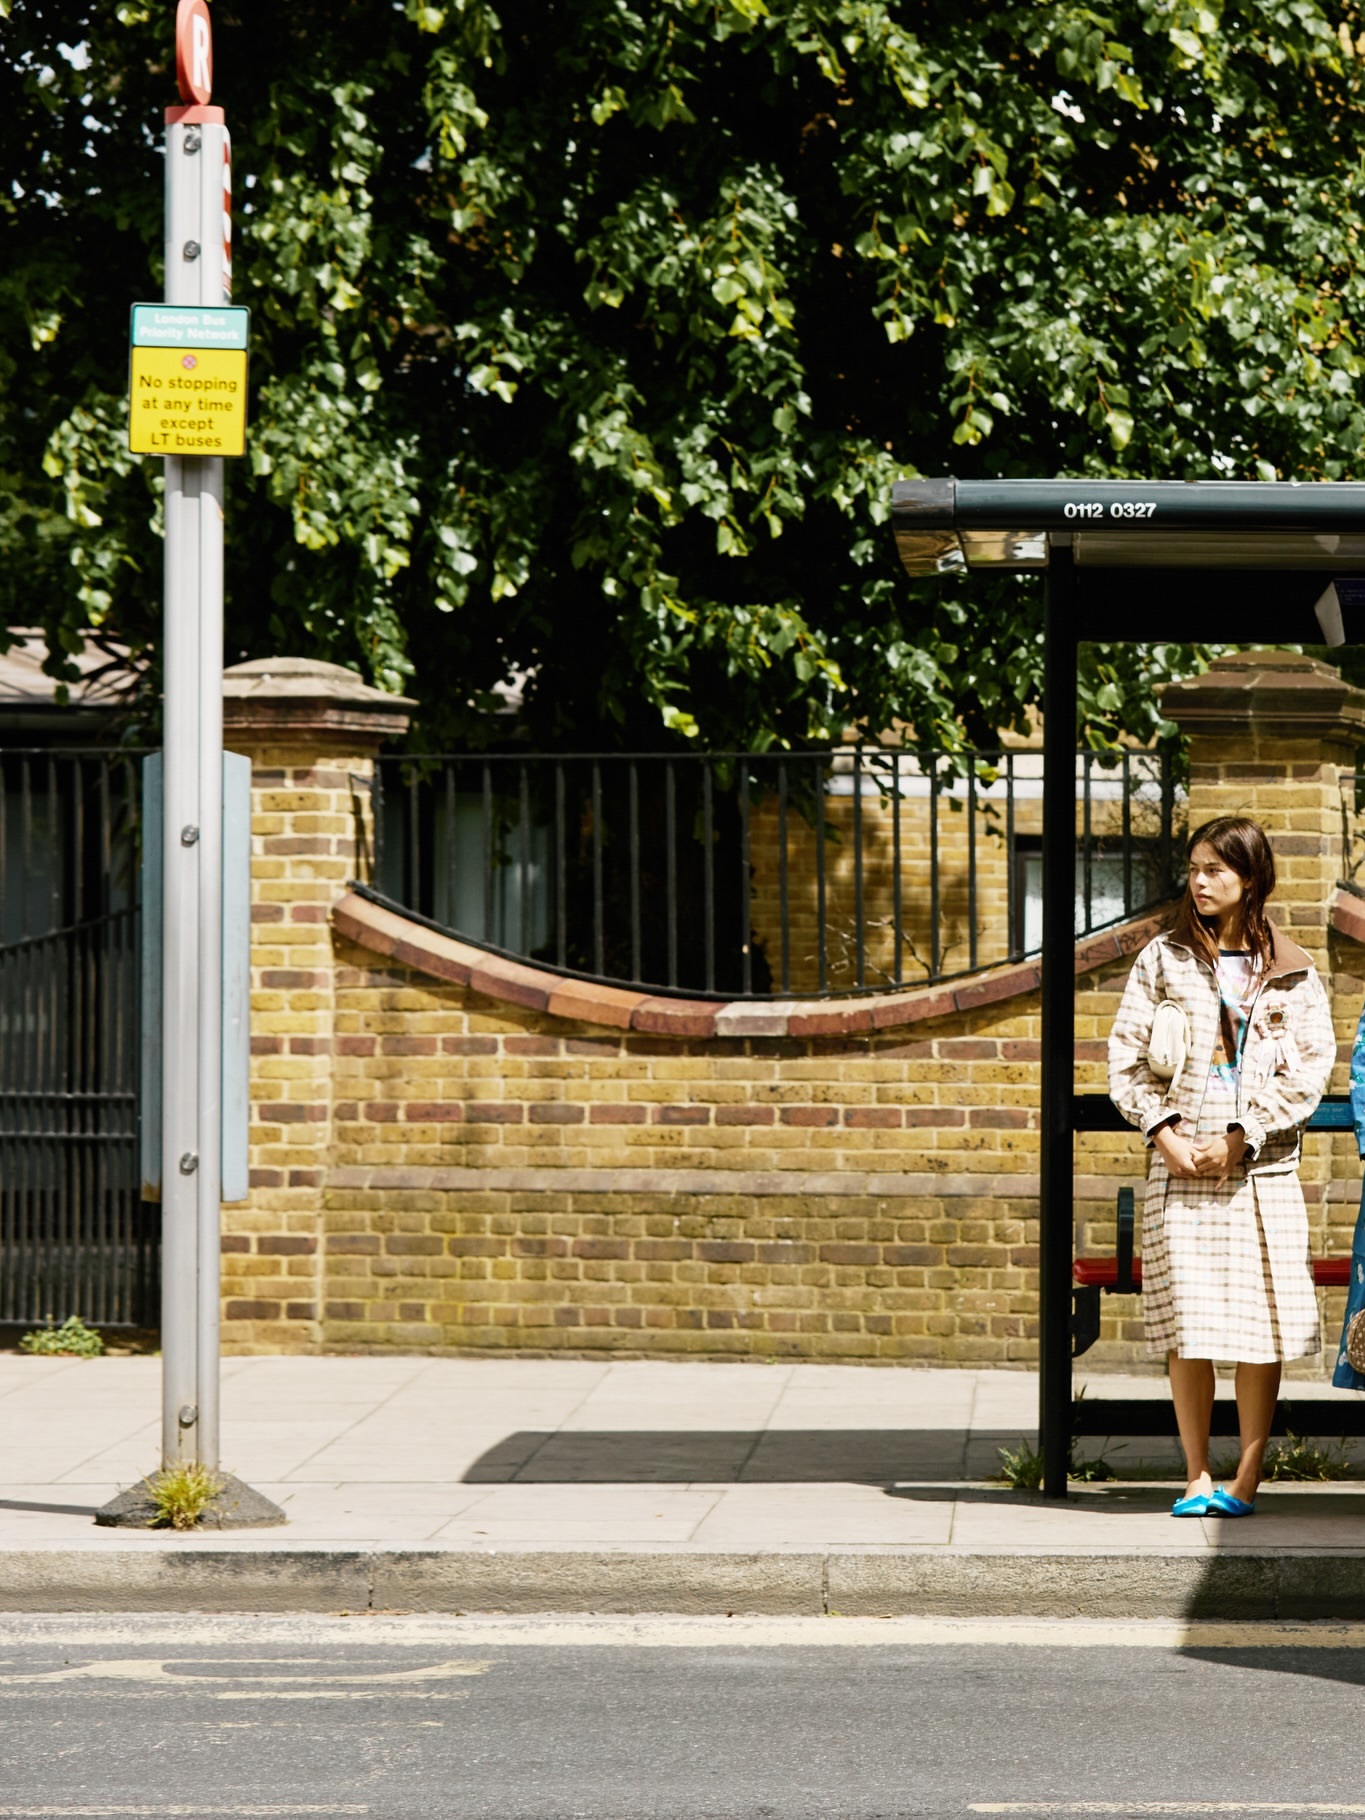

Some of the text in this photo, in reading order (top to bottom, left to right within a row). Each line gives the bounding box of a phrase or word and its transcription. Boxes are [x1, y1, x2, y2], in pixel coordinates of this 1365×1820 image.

[154, 313, 226, 326] London Bus
[140, 327, 239, 340] Priority Network
[140, 375, 238, 393] No stopping
[142, 398, 233, 413] at any time
[160, 418, 214, 431] except
[151, 433, 222, 447] LT buses
[1063, 502, 1157, 518] 0112 0327
